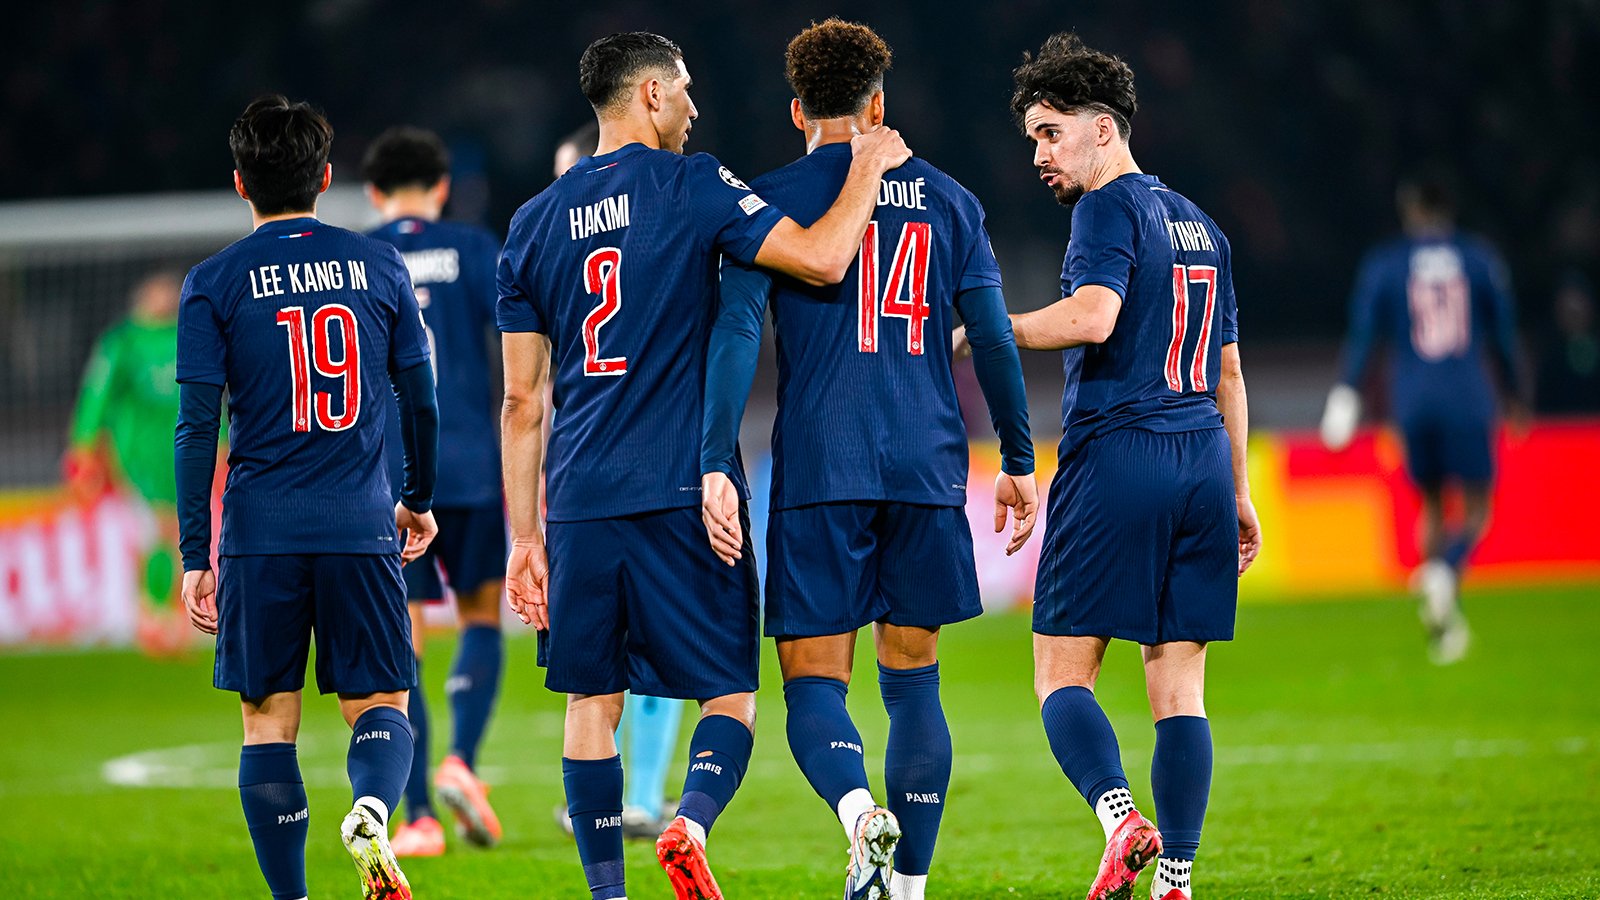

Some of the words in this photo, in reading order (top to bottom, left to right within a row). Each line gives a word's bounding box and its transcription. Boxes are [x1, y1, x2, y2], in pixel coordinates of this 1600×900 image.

[876, 177, 928, 211] DOUÉ
[569, 193, 630, 241] HAKIMI
[250, 265, 284, 299] LEE
[288, 260, 344, 294] KANG
[347, 260, 368, 291] IN
[858, 220, 932, 356] 14
[581, 246, 628, 377] 2
[1164, 263, 1218, 393] 17
[276, 303, 361, 432] 19
[356, 730, 390, 744] PARIS
[830, 741, 863, 755] PARIS
[691, 762, 723, 776] PARIS
[905, 792, 940, 804] PARIS
[278, 807, 308, 825] PARIS
[595, 816, 622, 830] PARIS
